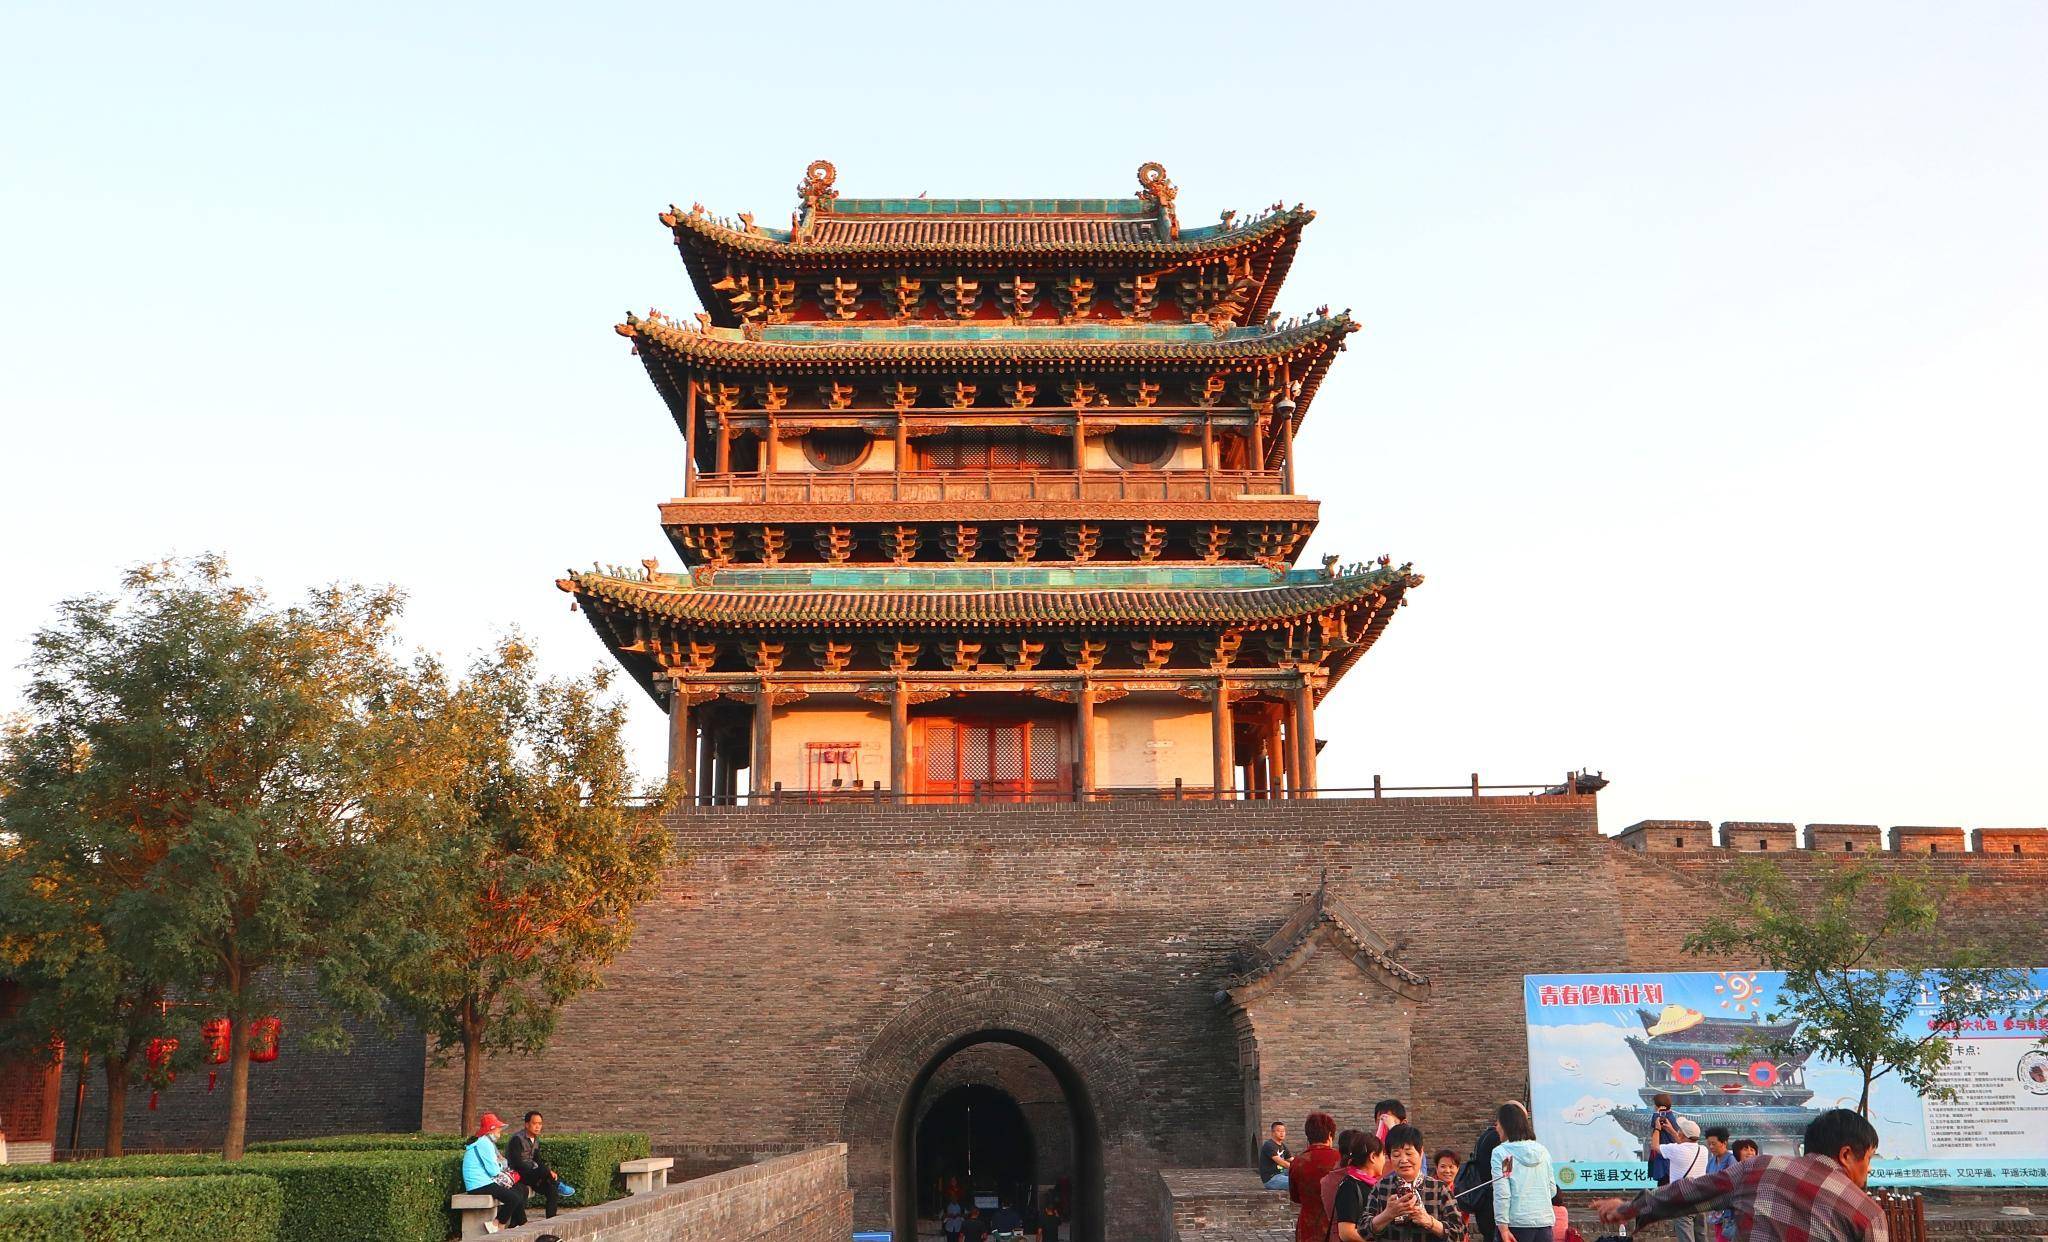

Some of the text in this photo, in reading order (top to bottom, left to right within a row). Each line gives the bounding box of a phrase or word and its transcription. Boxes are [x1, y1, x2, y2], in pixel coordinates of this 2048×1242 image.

[1539, 984, 1664, 1006] 青春修炼计划
[1580, 1168, 1654, 1182] 平遥县文化
